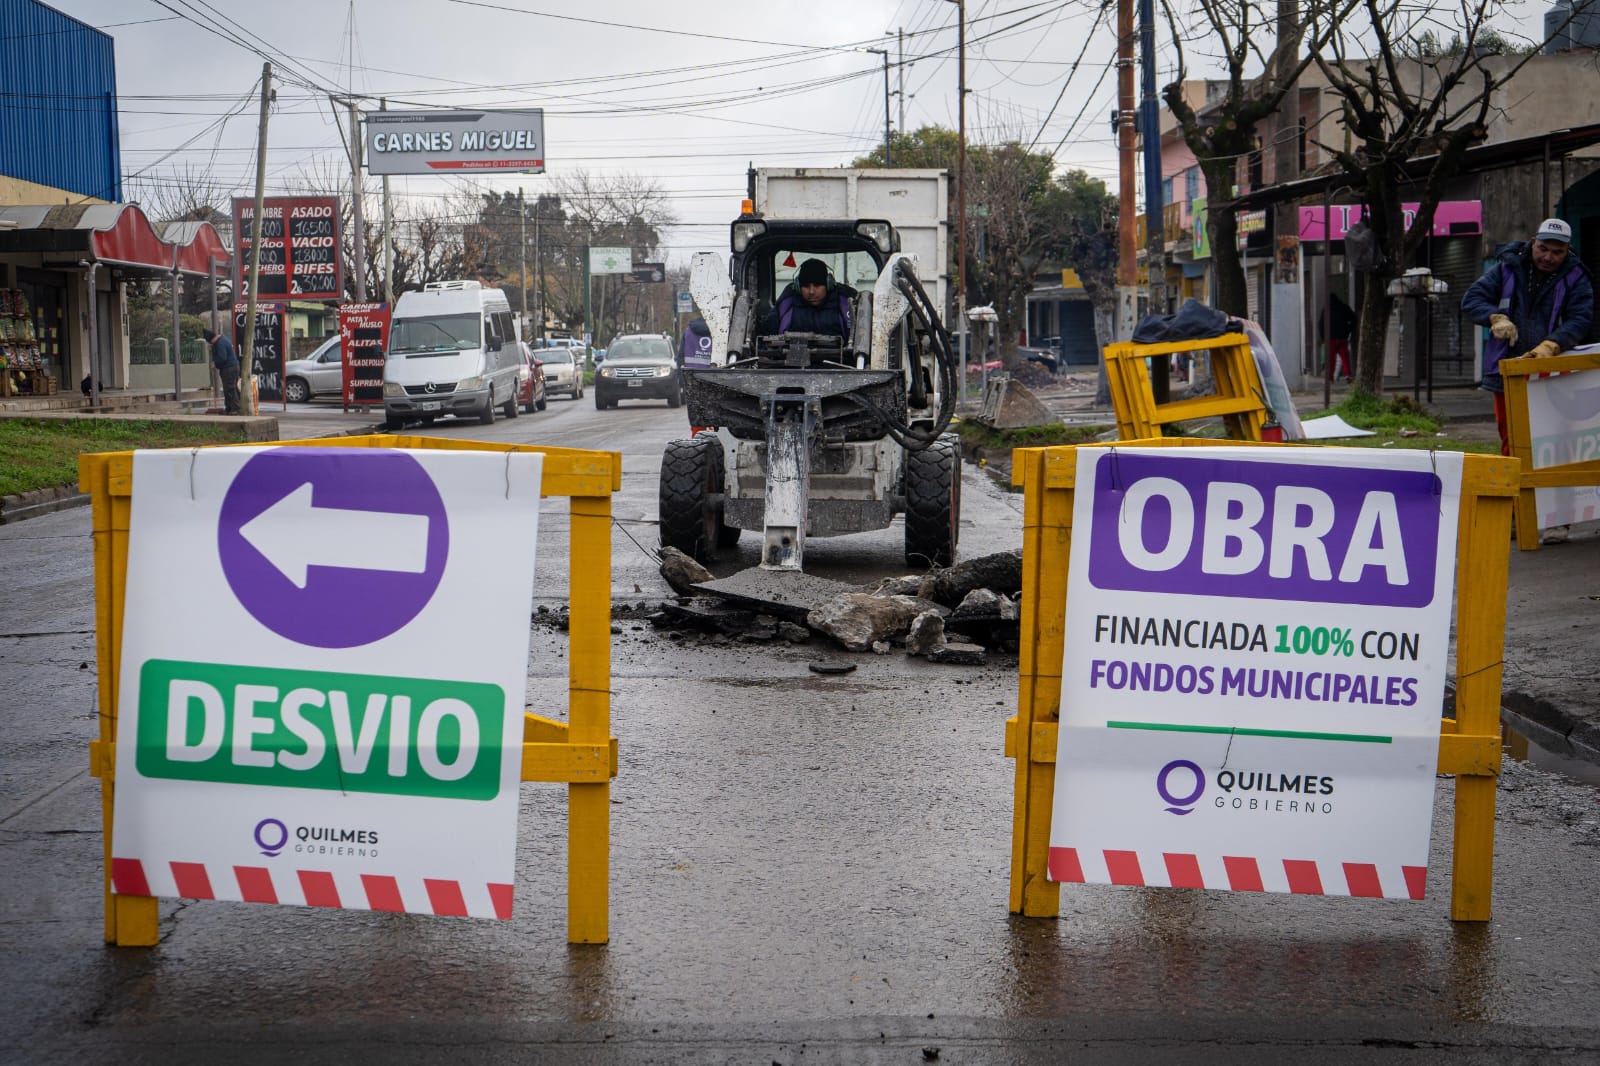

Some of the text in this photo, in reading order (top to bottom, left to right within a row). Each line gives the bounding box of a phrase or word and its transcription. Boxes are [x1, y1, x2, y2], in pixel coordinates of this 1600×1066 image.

[374, 130, 536, 152] CARNES MIGUEL
[291, 207, 332, 217] ASADO
[295, 220, 331, 236] 16500
[292, 237, 333, 248] VACIO
[294, 263, 334, 274] BIFES
[348, 339, 383, 347] ALITAS
[1118, 476, 1409, 586] OBRA
[1095, 614, 1420, 661] FINANCIADA 100% CON
[1090, 660, 1418, 707] FONDOS MUNICIPALES
[165, 678, 481, 781] DESVIO
[1216, 770, 1334, 795] QUILMES
[1215, 797, 1332, 814] GOBIERNO
[296, 826, 379, 845] QUILMES
[294, 844, 379, 858] GOBIERNO
